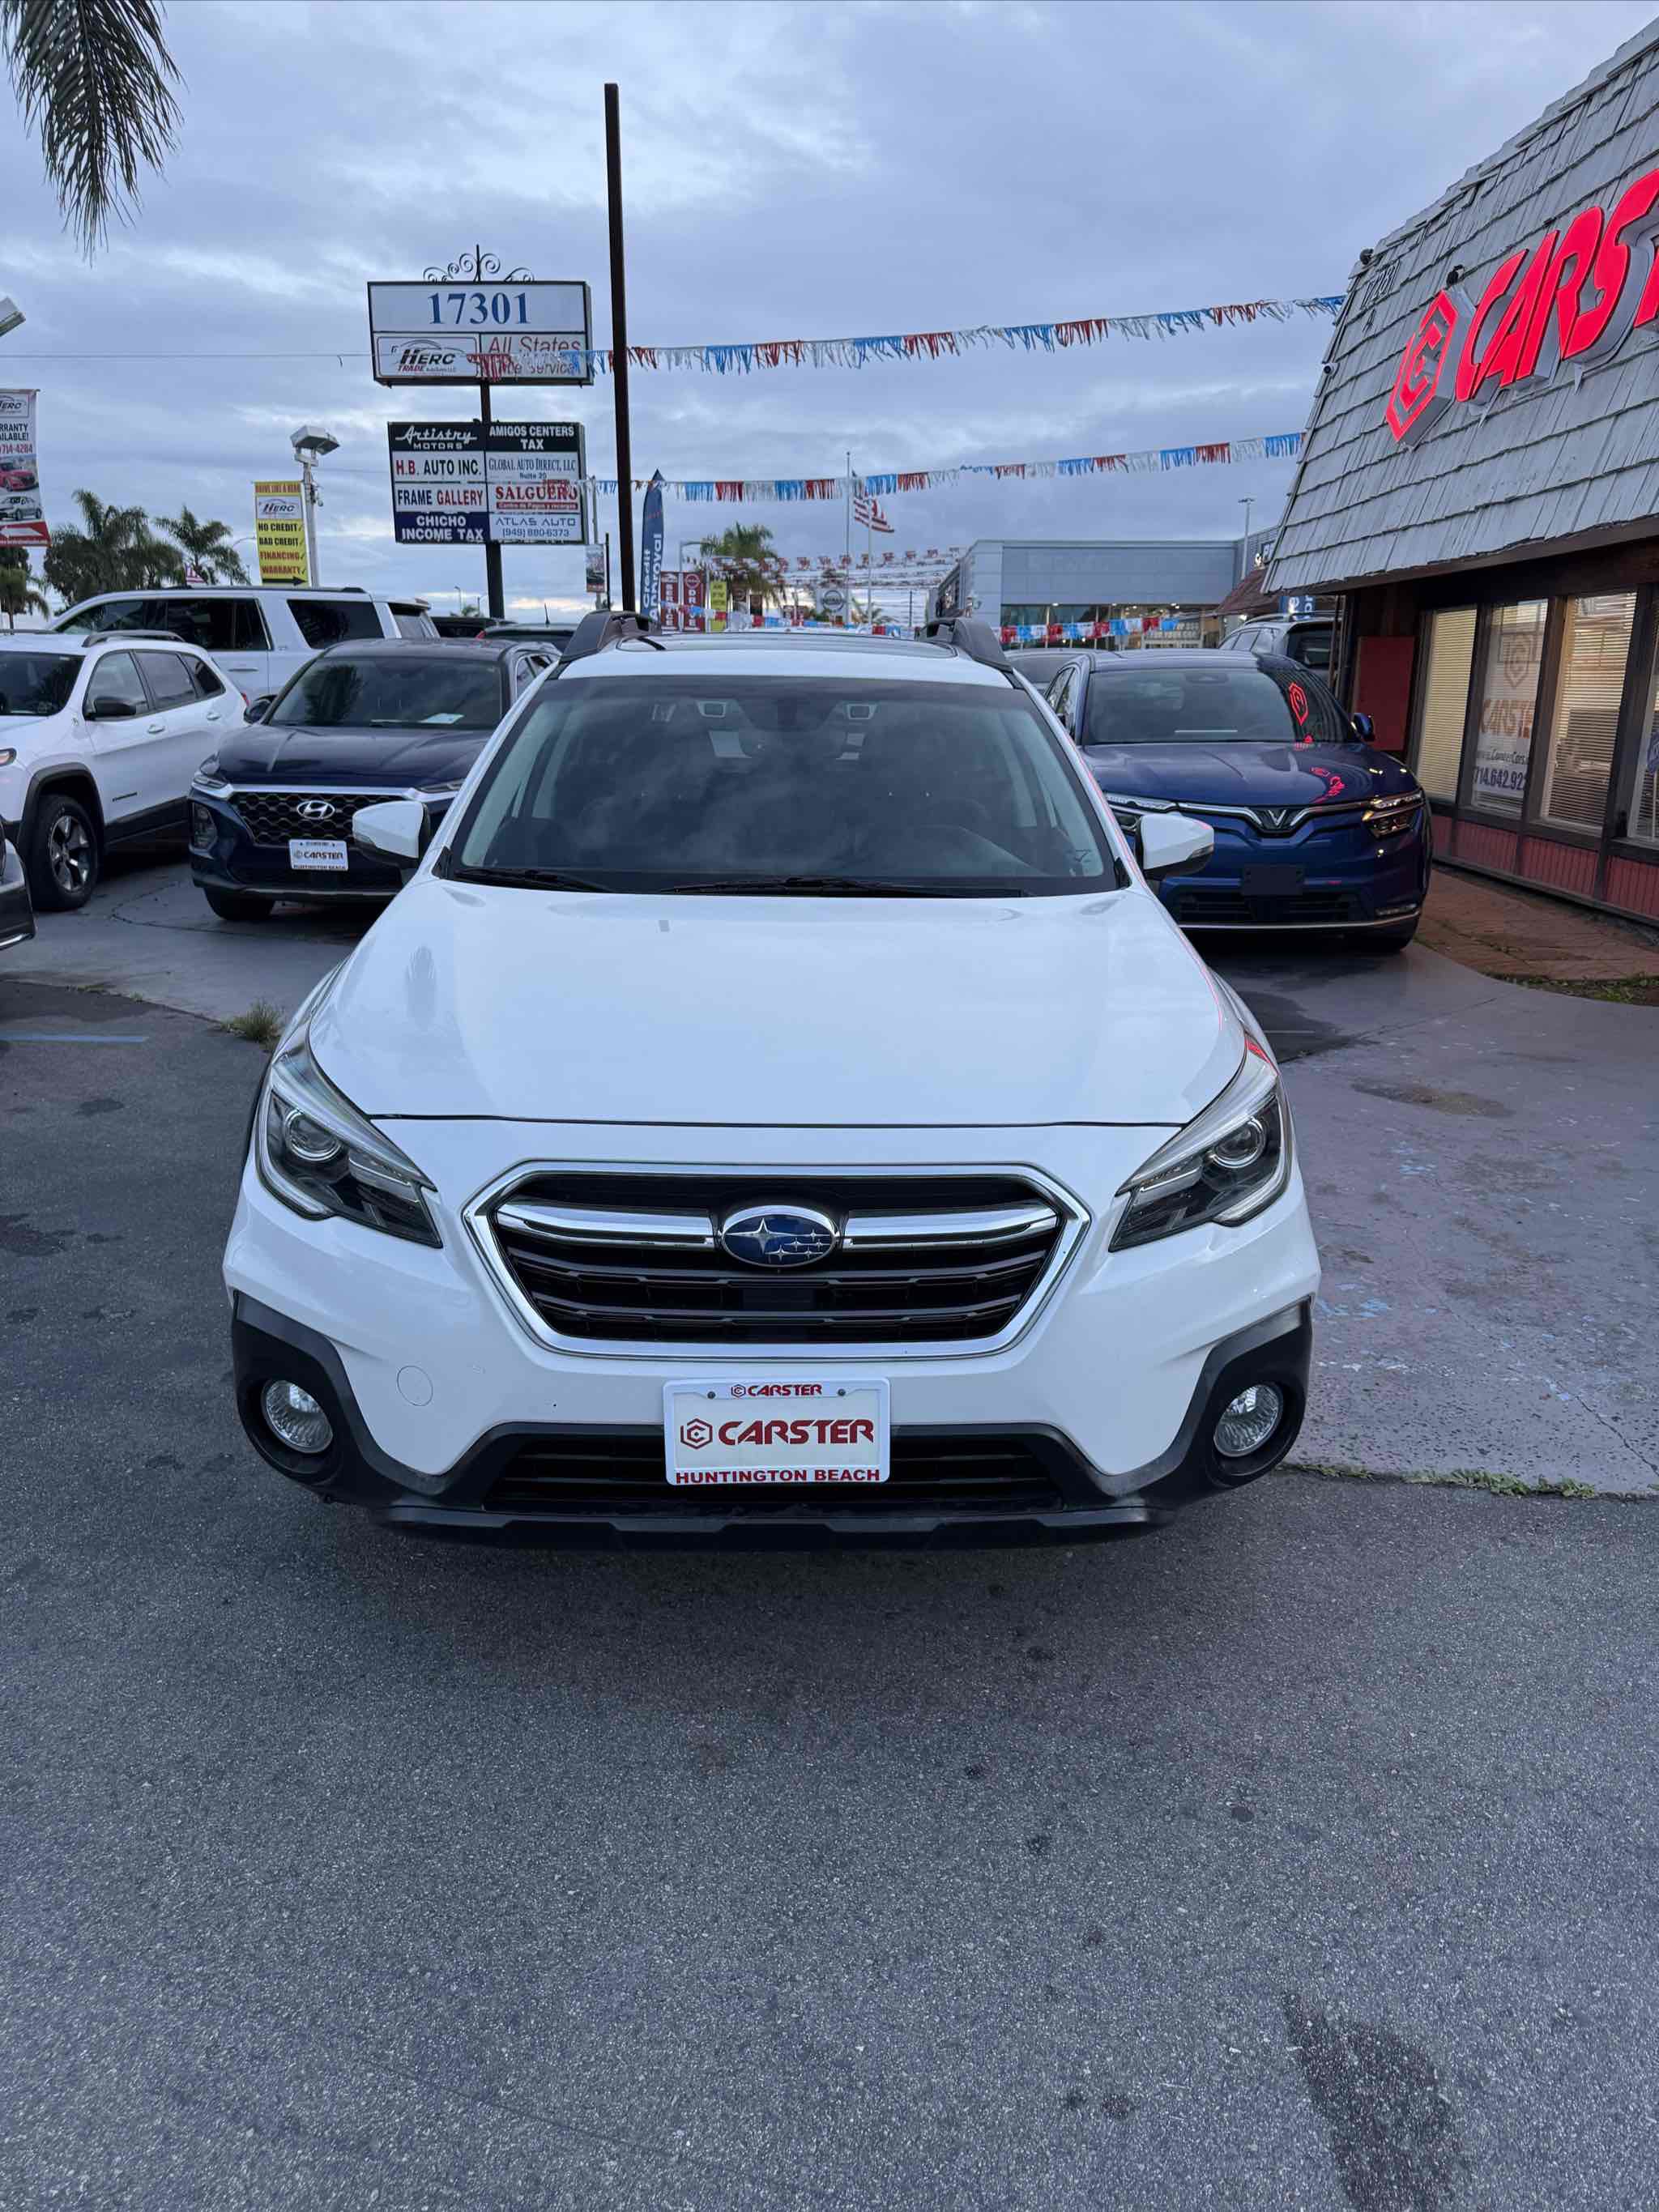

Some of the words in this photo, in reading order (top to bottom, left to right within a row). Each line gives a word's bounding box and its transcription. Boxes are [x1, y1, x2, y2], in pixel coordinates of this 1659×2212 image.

[429, 292, 531, 325] 17301
[488, 336, 513, 353] All
[520, 336, 581, 354] States
[400, 349, 456, 365] HERC
[0, 401, 21, 409] ERC
[395, 425, 478, 444] Artistry
[489, 426, 527, 437] AMIGOS
[529, 426, 574, 437] CENTERS
[520, 438, 544, 450] TAX
[424, 459, 454, 475] AUTO
[458, 459, 482, 476] INC.
[488, 458, 515, 471] GLOBAL
[517, 458, 535, 471] AUTO
[535, 458, 562, 472] DIRECT,
[563, 459, 576, 471] LLC
[398, 489, 433, 506] FRAME
[437, 489, 484, 506] GALLERY
[271, 522, 298, 532] CREDIT
[416, 515, 467, 527] CHICHO
[496, 518, 537, 526] ATLAS
[541, 518, 576, 526] AUTO
[401, 528, 453, 541] INCOME
[457, 528, 484, 541] TAX
[274, 537, 298, 547] CREDIT
[748, 1383, 822, 1396] CARSTER
[718, 1419, 874, 1445] CARSTER
[676, 1469, 807, 1484] HUNTINGTON
[814, 1469, 880, 1481] BEACH
